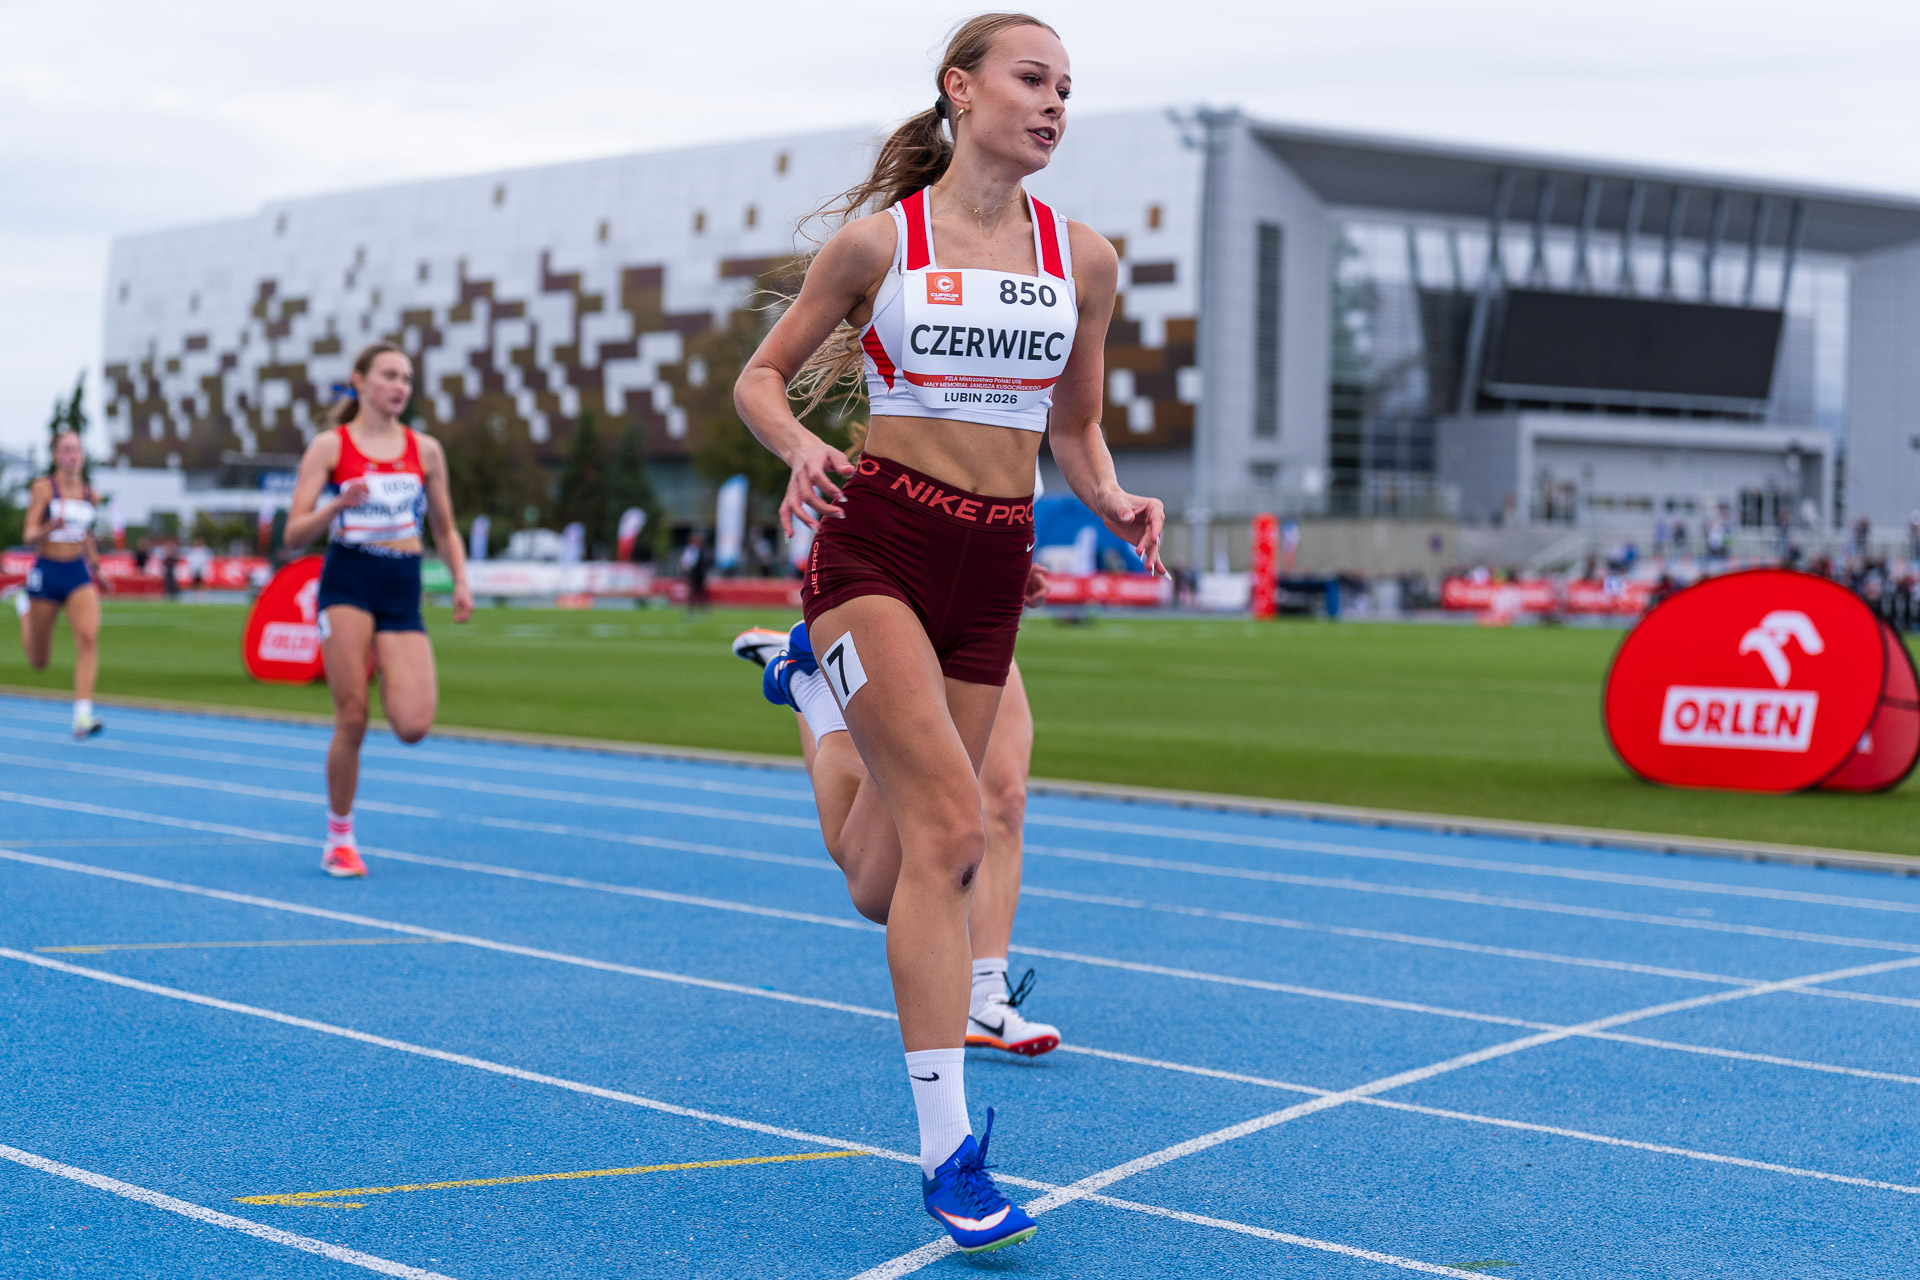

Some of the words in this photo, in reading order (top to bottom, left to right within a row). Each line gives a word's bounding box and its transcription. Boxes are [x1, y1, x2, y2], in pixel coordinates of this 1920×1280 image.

[999, 279, 1057, 308] 850
[910, 324, 1066, 362] CZERWIEC
[944, 392, 982, 403] LUBIN
[985, 393, 1018, 404] 2026
[890, 473, 983, 522] NIKE
[826, 643, 850, 698] 7
[1674, 700, 1802, 738] ORLEN
